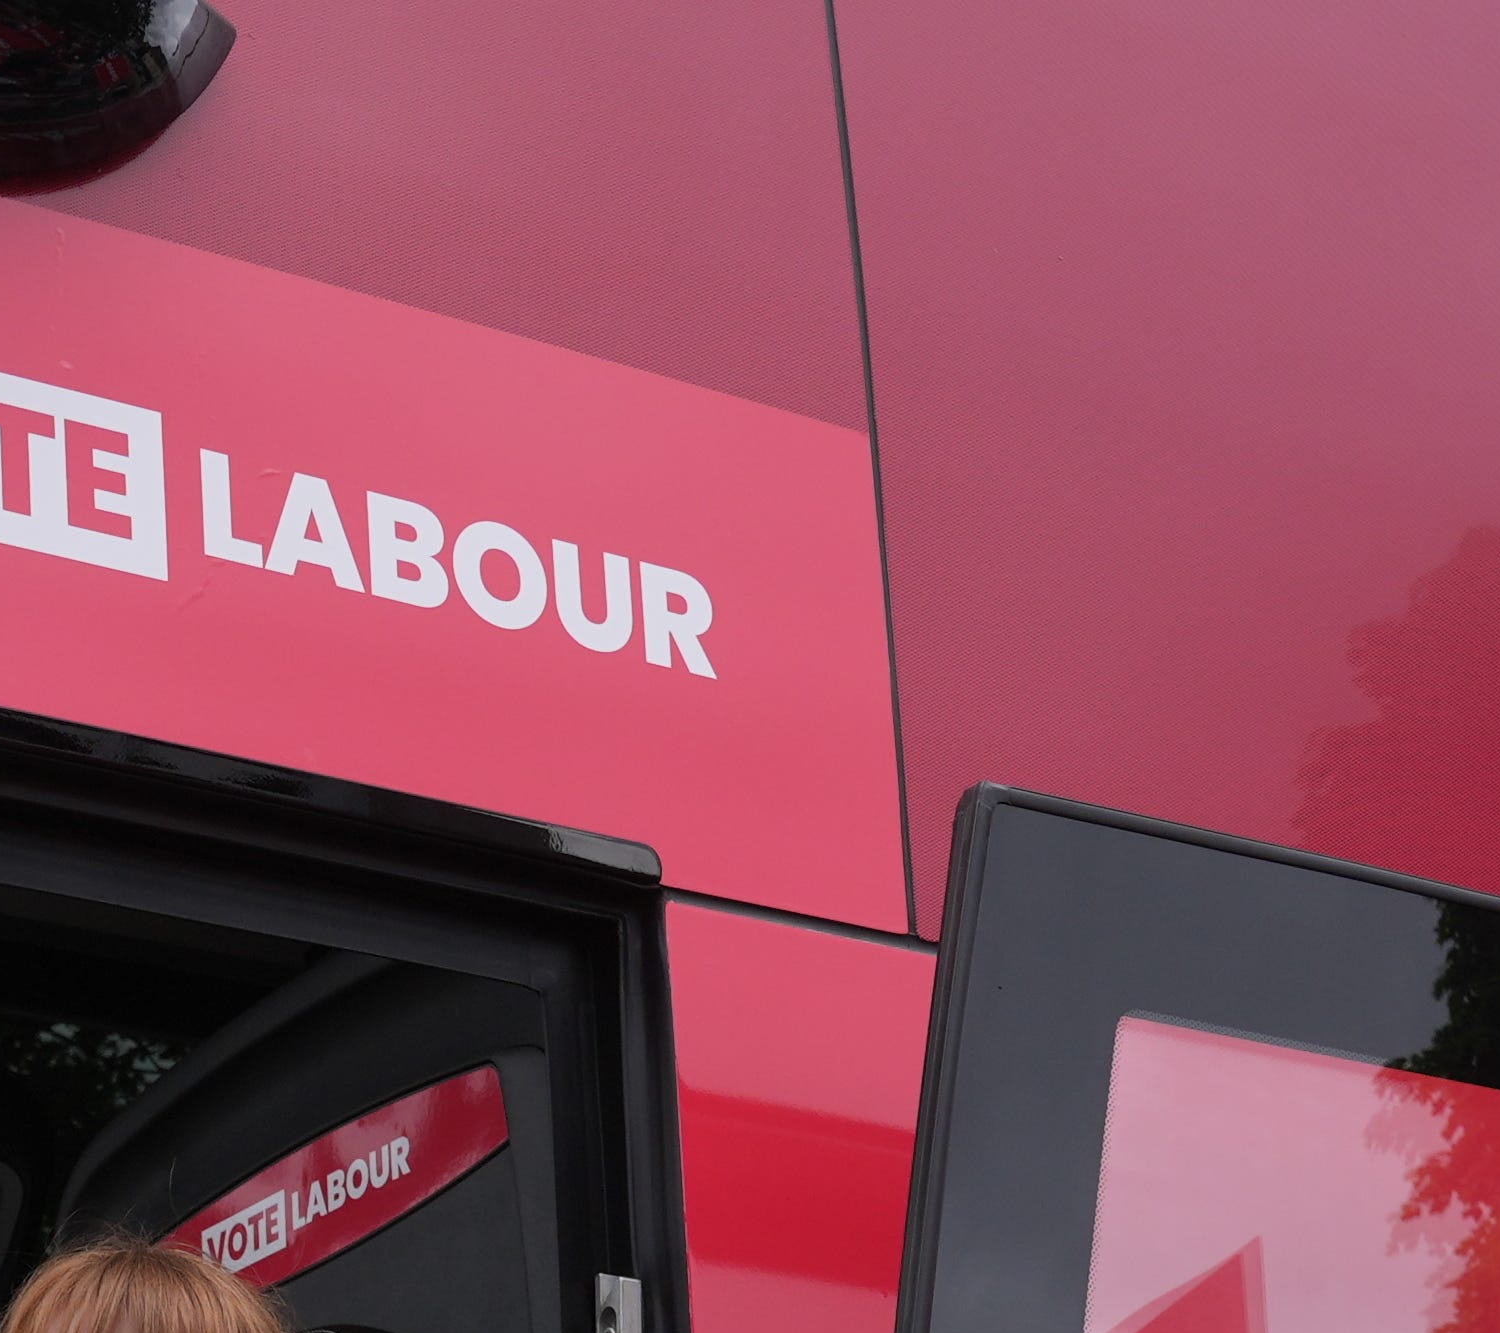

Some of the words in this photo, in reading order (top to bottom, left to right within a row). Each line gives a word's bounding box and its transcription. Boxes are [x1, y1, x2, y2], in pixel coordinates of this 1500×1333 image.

[200, 449, 717, 679] LABOUR
[207, 1203, 279, 1265] VOTE
[291, 1136, 411, 1231] LABOUR
